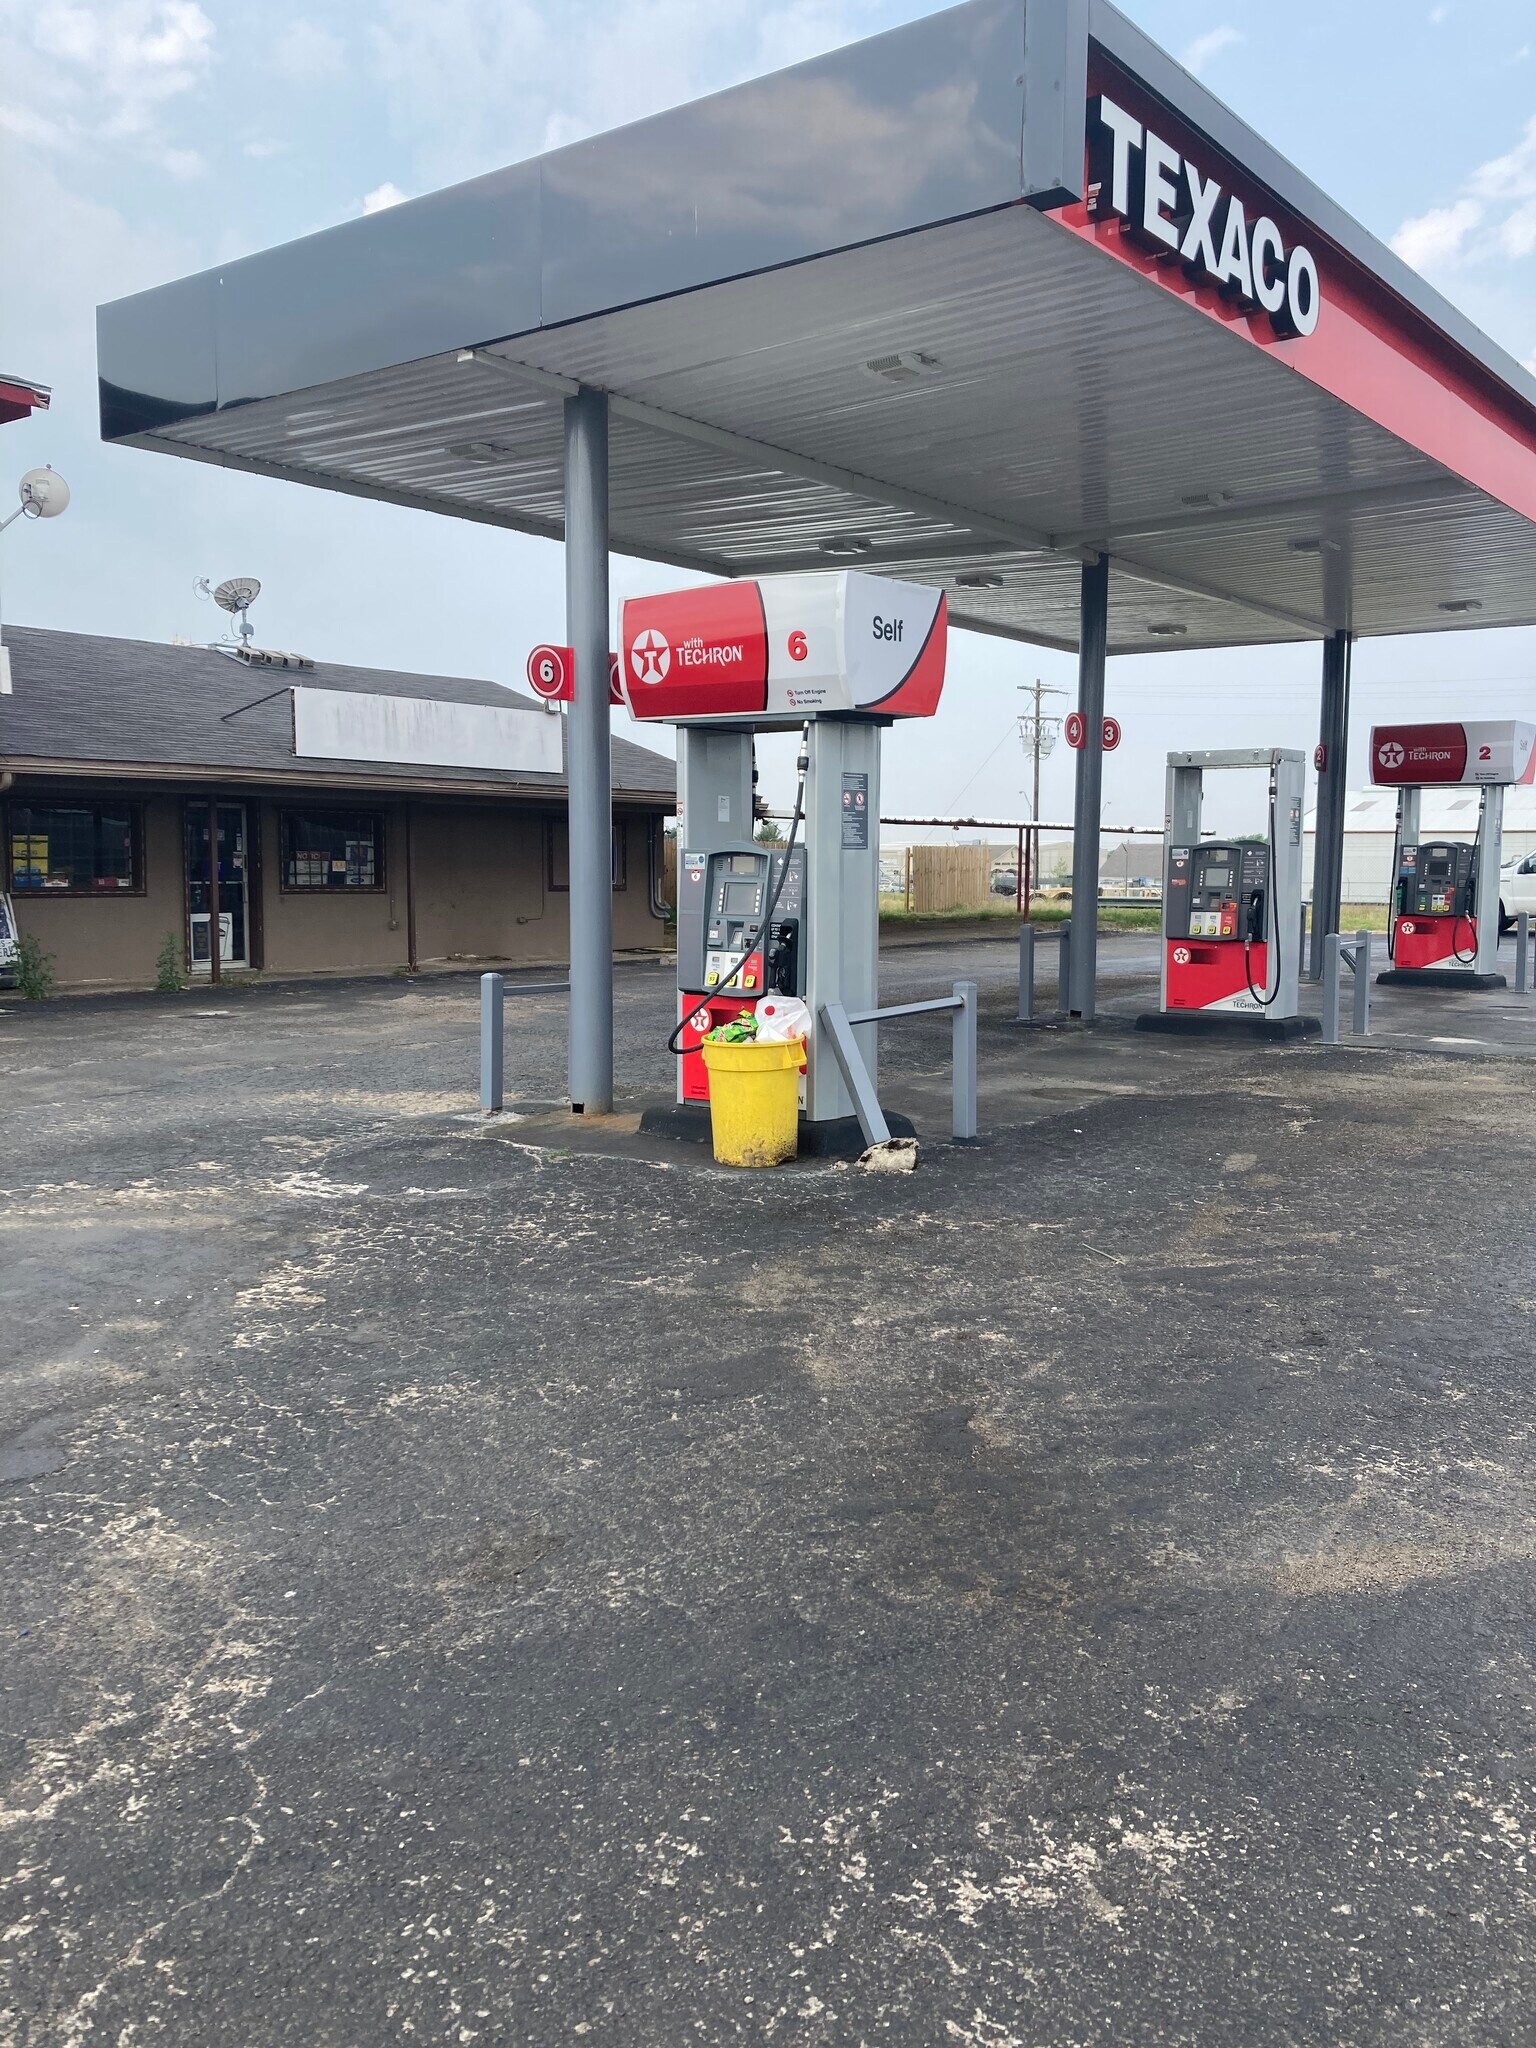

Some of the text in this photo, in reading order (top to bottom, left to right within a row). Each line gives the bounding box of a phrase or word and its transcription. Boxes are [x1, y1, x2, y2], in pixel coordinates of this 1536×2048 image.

[1100, 94, 1320, 337] TEXACO
[873, 615, 904, 642] Self
[683, 637, 704, 649] with
[787, 630, 808, 661] 6
[676, 645, 742, 666] TECHRON
[539, 659, 555, 683] 6
[1070, 722, 1078, 737] 4
[1104, 726, 1114, 741] 3
[1316, 750, 1322, 761] 2
[1408, 751, 1451, 761] TECHRON
[1479, 745, 1491, 760] 2
